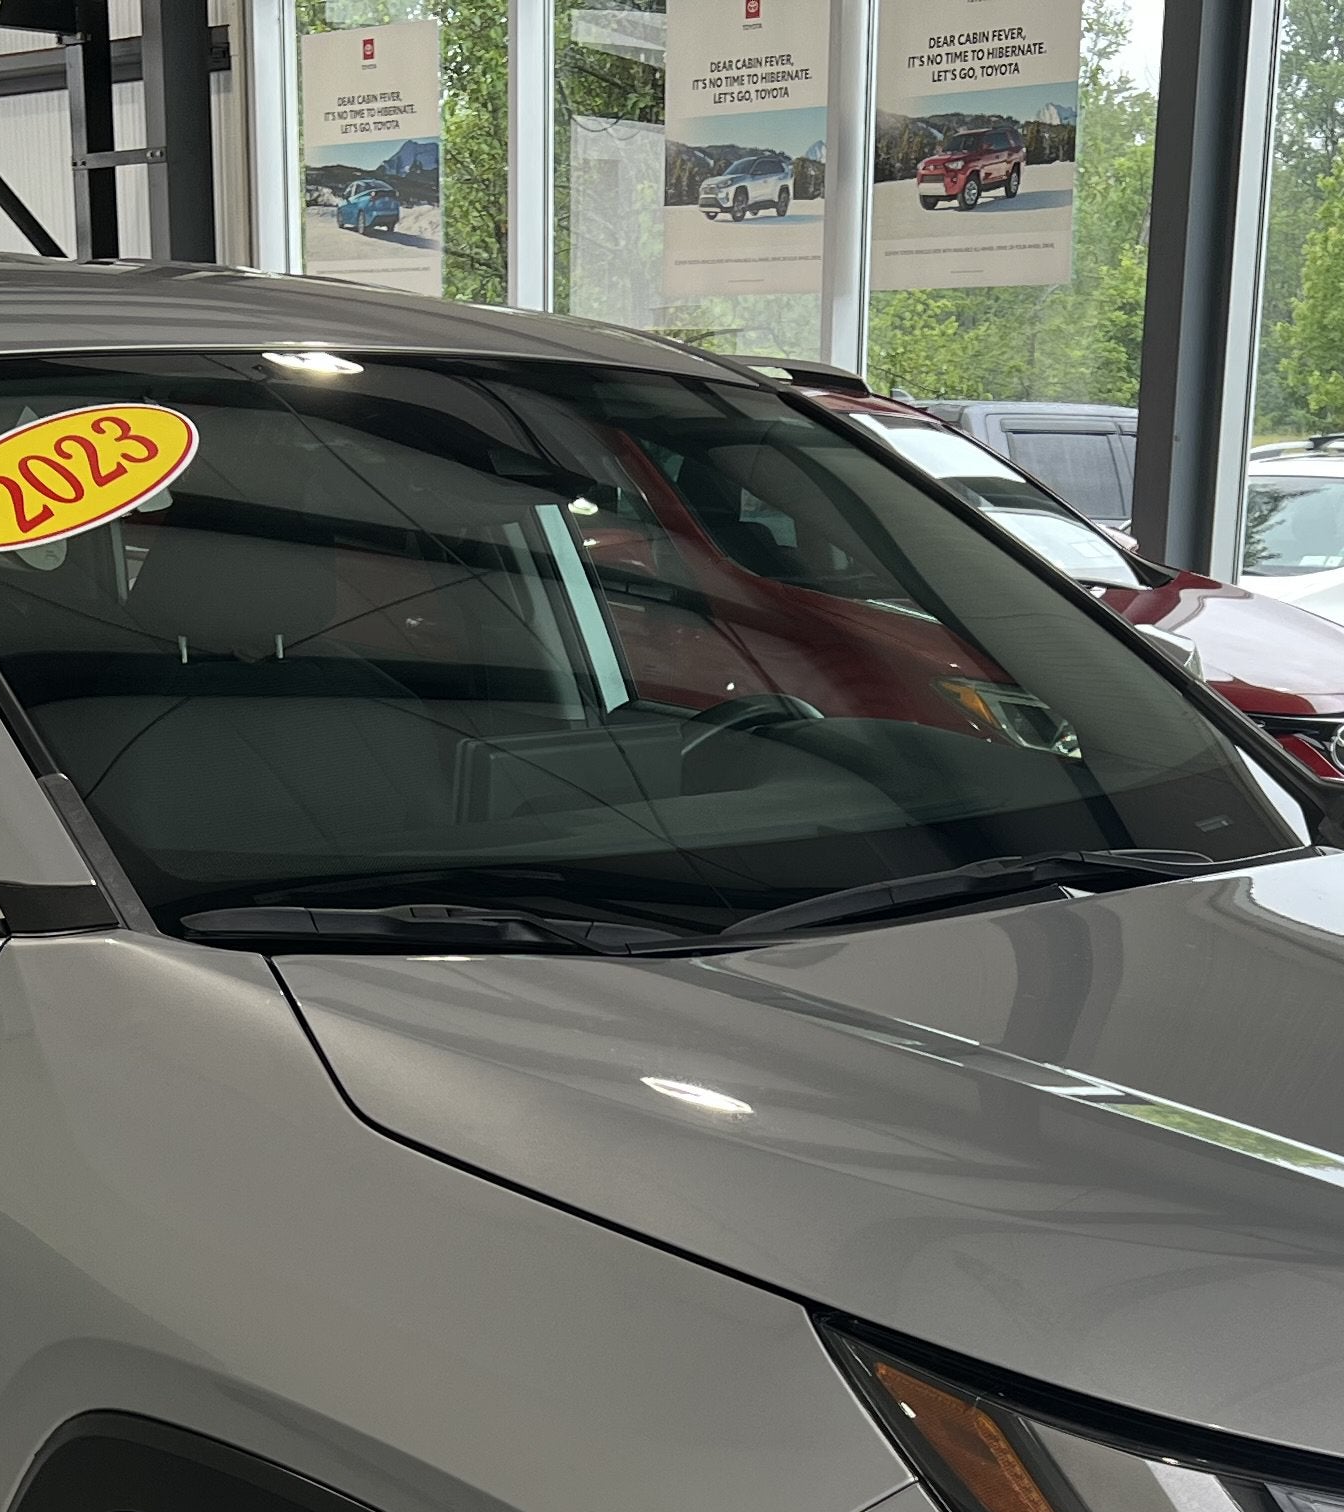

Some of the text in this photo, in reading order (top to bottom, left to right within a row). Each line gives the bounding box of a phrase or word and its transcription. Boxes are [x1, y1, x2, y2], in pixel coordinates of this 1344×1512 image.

[929, 27, 1026, 49] DEAR CABIN FEVER,
[710, 54, 794, 73] DEAR CABIN FEVER,
[908, 42, 1047, 69] IT'S NO TIME TO HIBERNATE.
[692, 68, 813, 90] IT'S NO TIME TO HIBERNATE.
[932, 62, 1020, 83] LET'S GO, TOYOTA
[337, 96, 355, 106] DEAR
[357, 94, 377, 105] CABIN
[713, 87, 790, 104] LET'S GO, TOYOTA
[338, 110, 348, 120] NO
[349, 109, 365, 119] TIME
[367, 108, 375, 117] TO
[373, 120, 400, 131] TOYOTA
